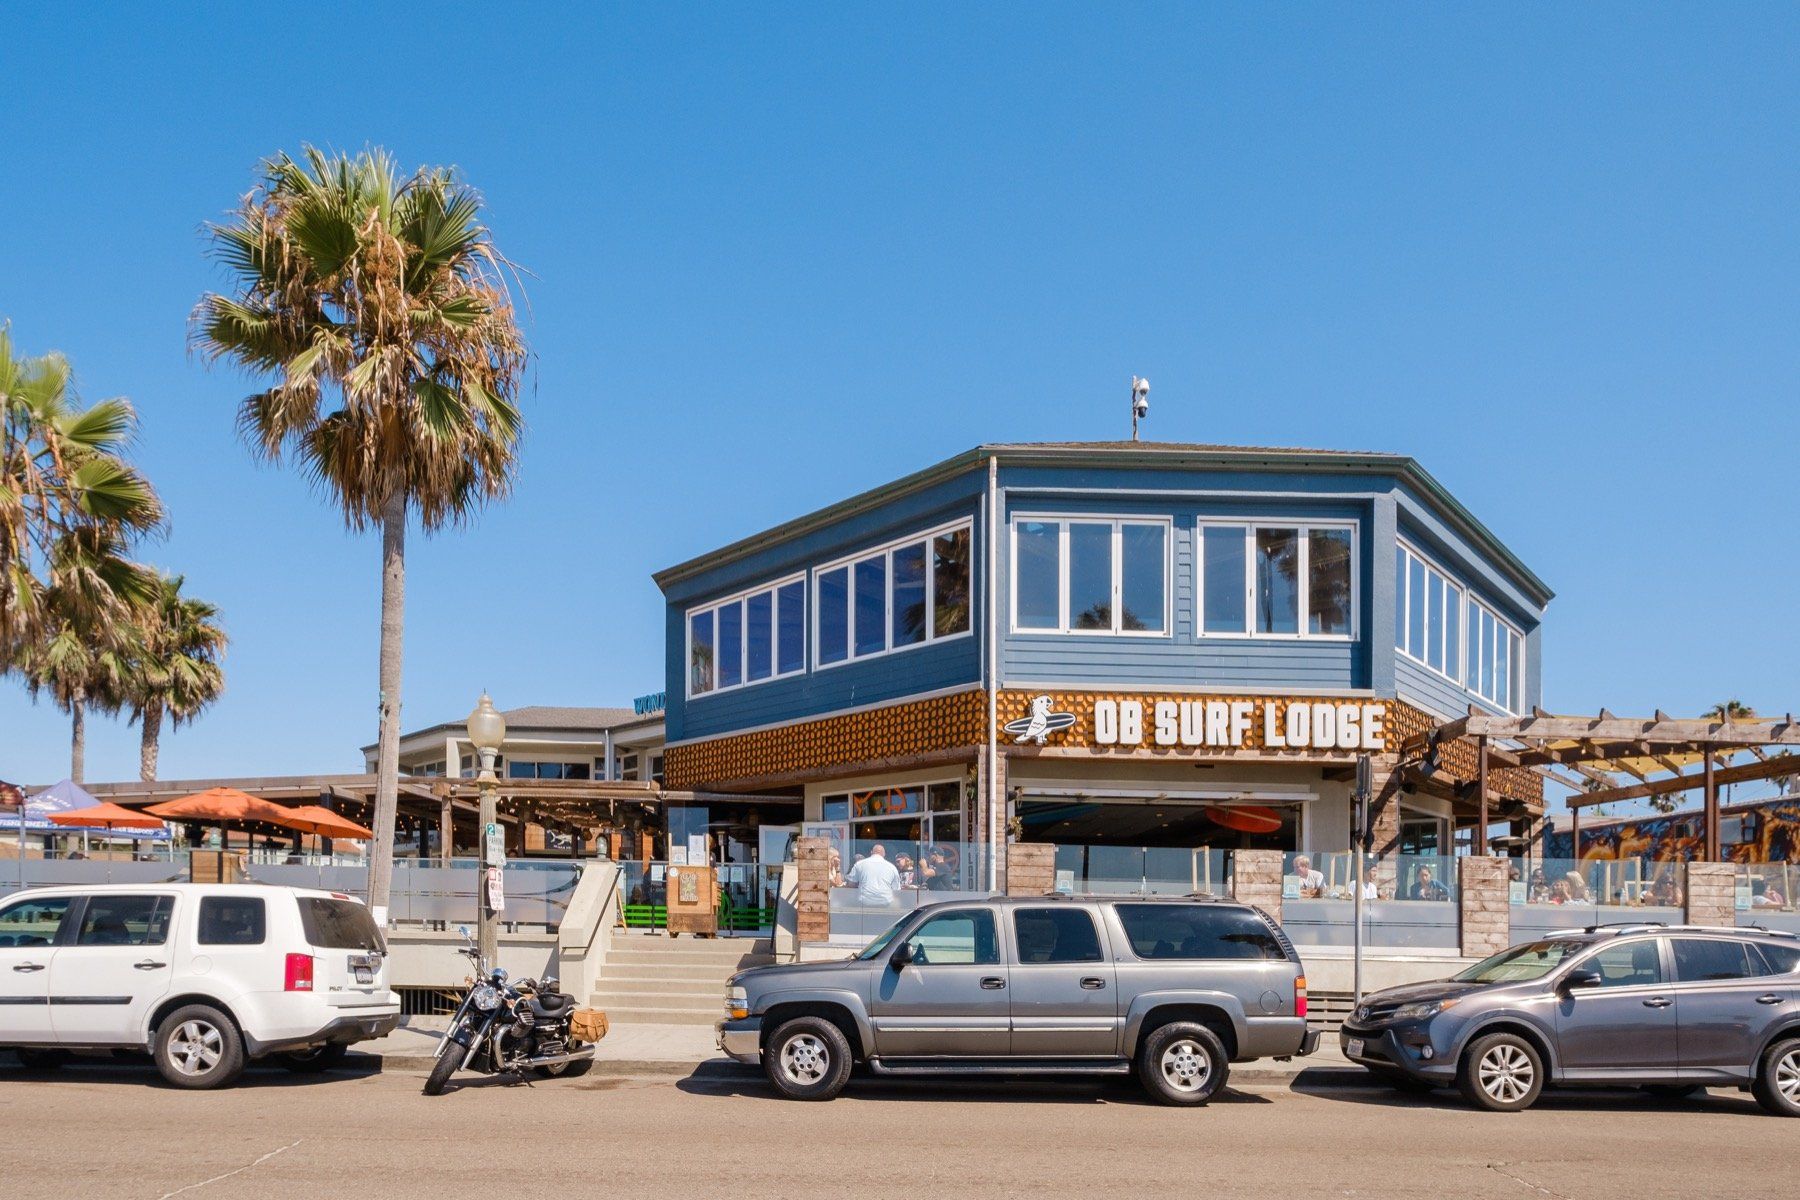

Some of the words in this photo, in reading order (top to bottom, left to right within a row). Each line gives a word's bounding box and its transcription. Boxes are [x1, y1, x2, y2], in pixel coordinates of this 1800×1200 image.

[1095, 700, 1143, 744] OB
[1155, 701, 1254, 746] SURF
[1264, 702, 1386, 749] LODGE
[488, 824, 495, 835] 2
